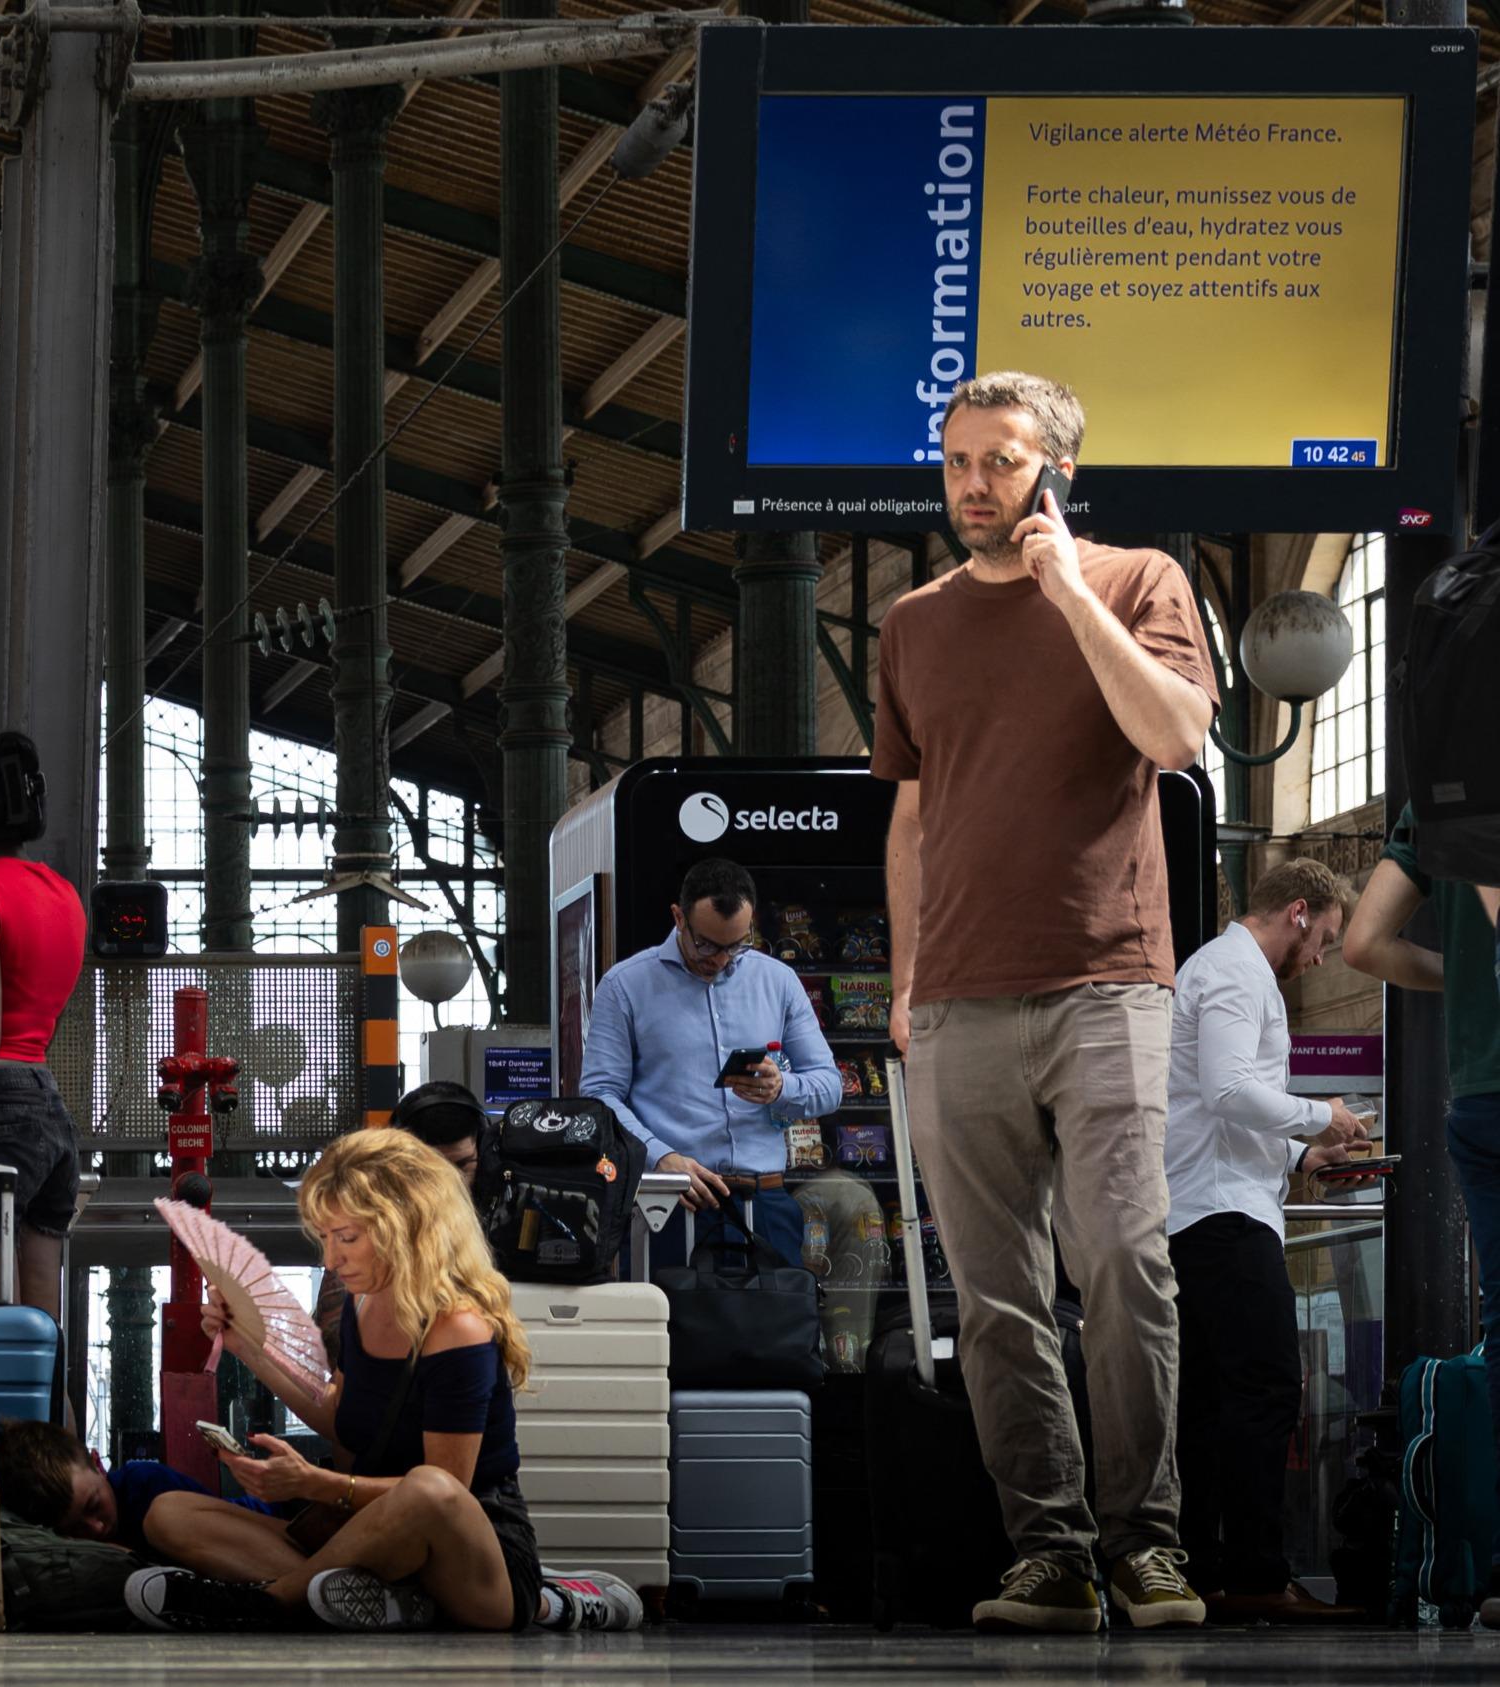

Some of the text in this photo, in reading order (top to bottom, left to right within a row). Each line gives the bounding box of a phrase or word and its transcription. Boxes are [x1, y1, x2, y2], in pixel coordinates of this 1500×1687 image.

[1030, 123, 1341, 146] Vigilance alerte Météo France.
[1028, 185, 1355, 207] Forte chaleur, munissez vous de
[1027, 216, 1342, 239] bouteilles d'eau, hydratez vous
[1025, 248, 1320, 270] régulièrement pendant votre
[1023, 279, 1319, 301] voyage et soyez attentifs aux
[1021, 311, 1090, 327] autres.
[1304, 447, 1365, 462] 10 42 45
[762, 498, 1090, 516] Présence à quai obligatoire part
[1400, 514, 1431, 526] SNCF
[734, 806, 838, 830] selecta
[840, 982, 885, 992] HARIBO
[1291, 1045, 1363, 1055] VANT LE DÉPART
[171, 1124, 210, 1134] COLONNE
[177, 1138, 204, 1148] SECHE
